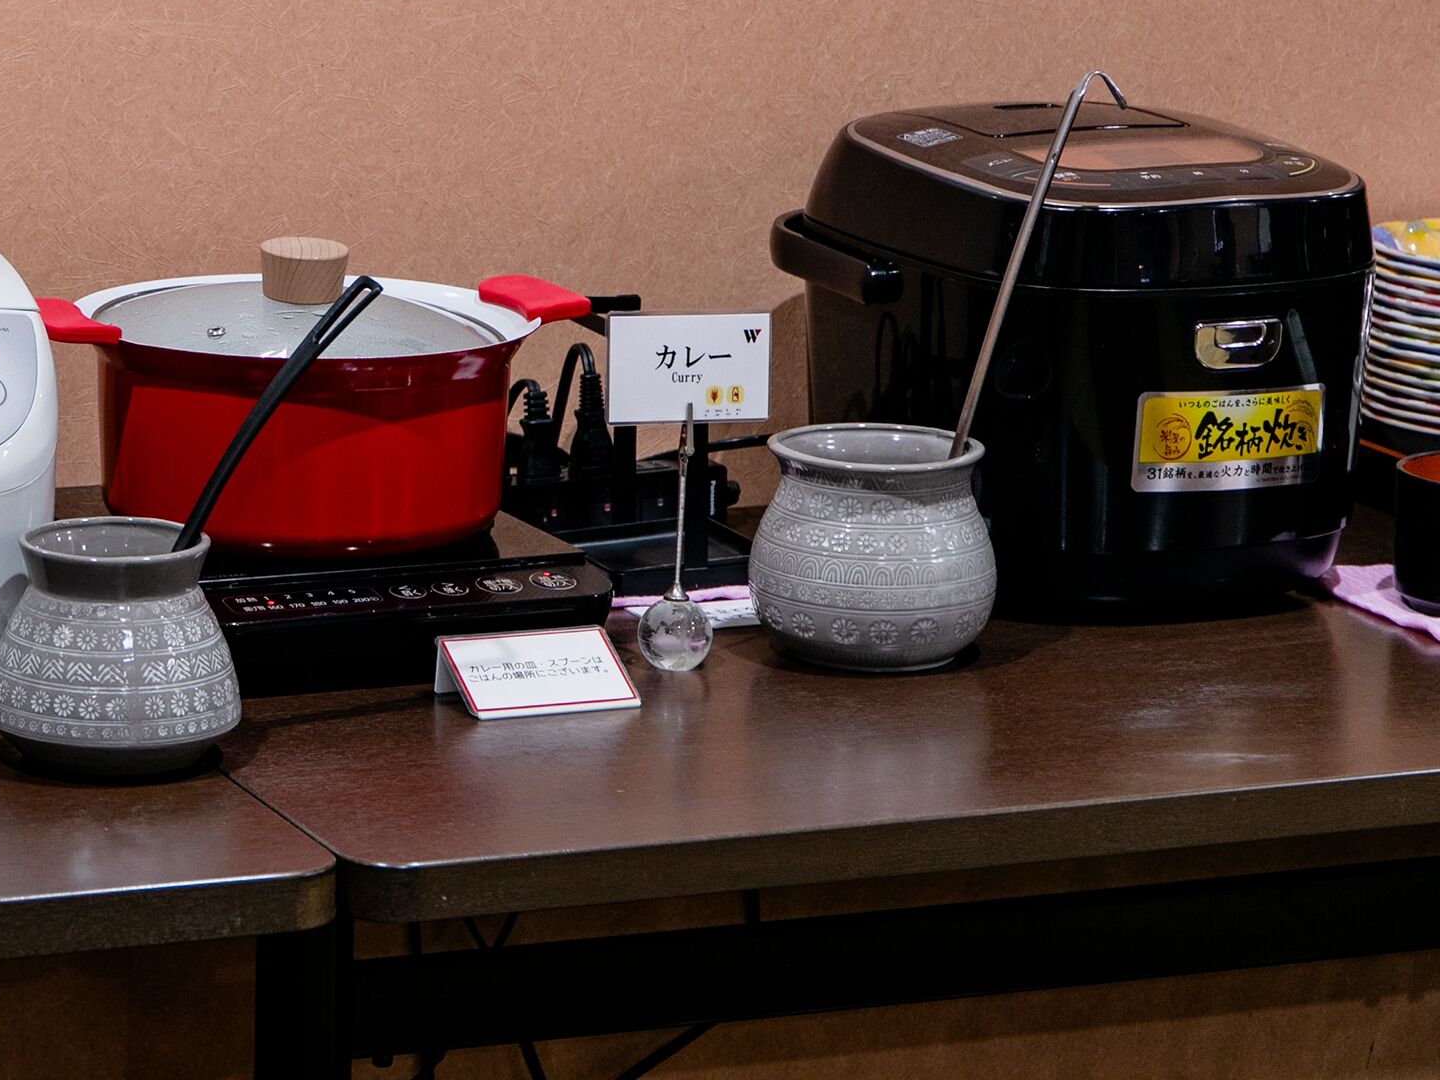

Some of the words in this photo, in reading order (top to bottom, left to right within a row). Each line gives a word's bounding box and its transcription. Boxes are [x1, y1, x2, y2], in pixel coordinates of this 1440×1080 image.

[655, 344, 733, 370] カレー
[671, 371, 703, 384] Curry
[1194, 408, 1308, 461] 銘柄炊き
[331, 598, 349, 606] 190
